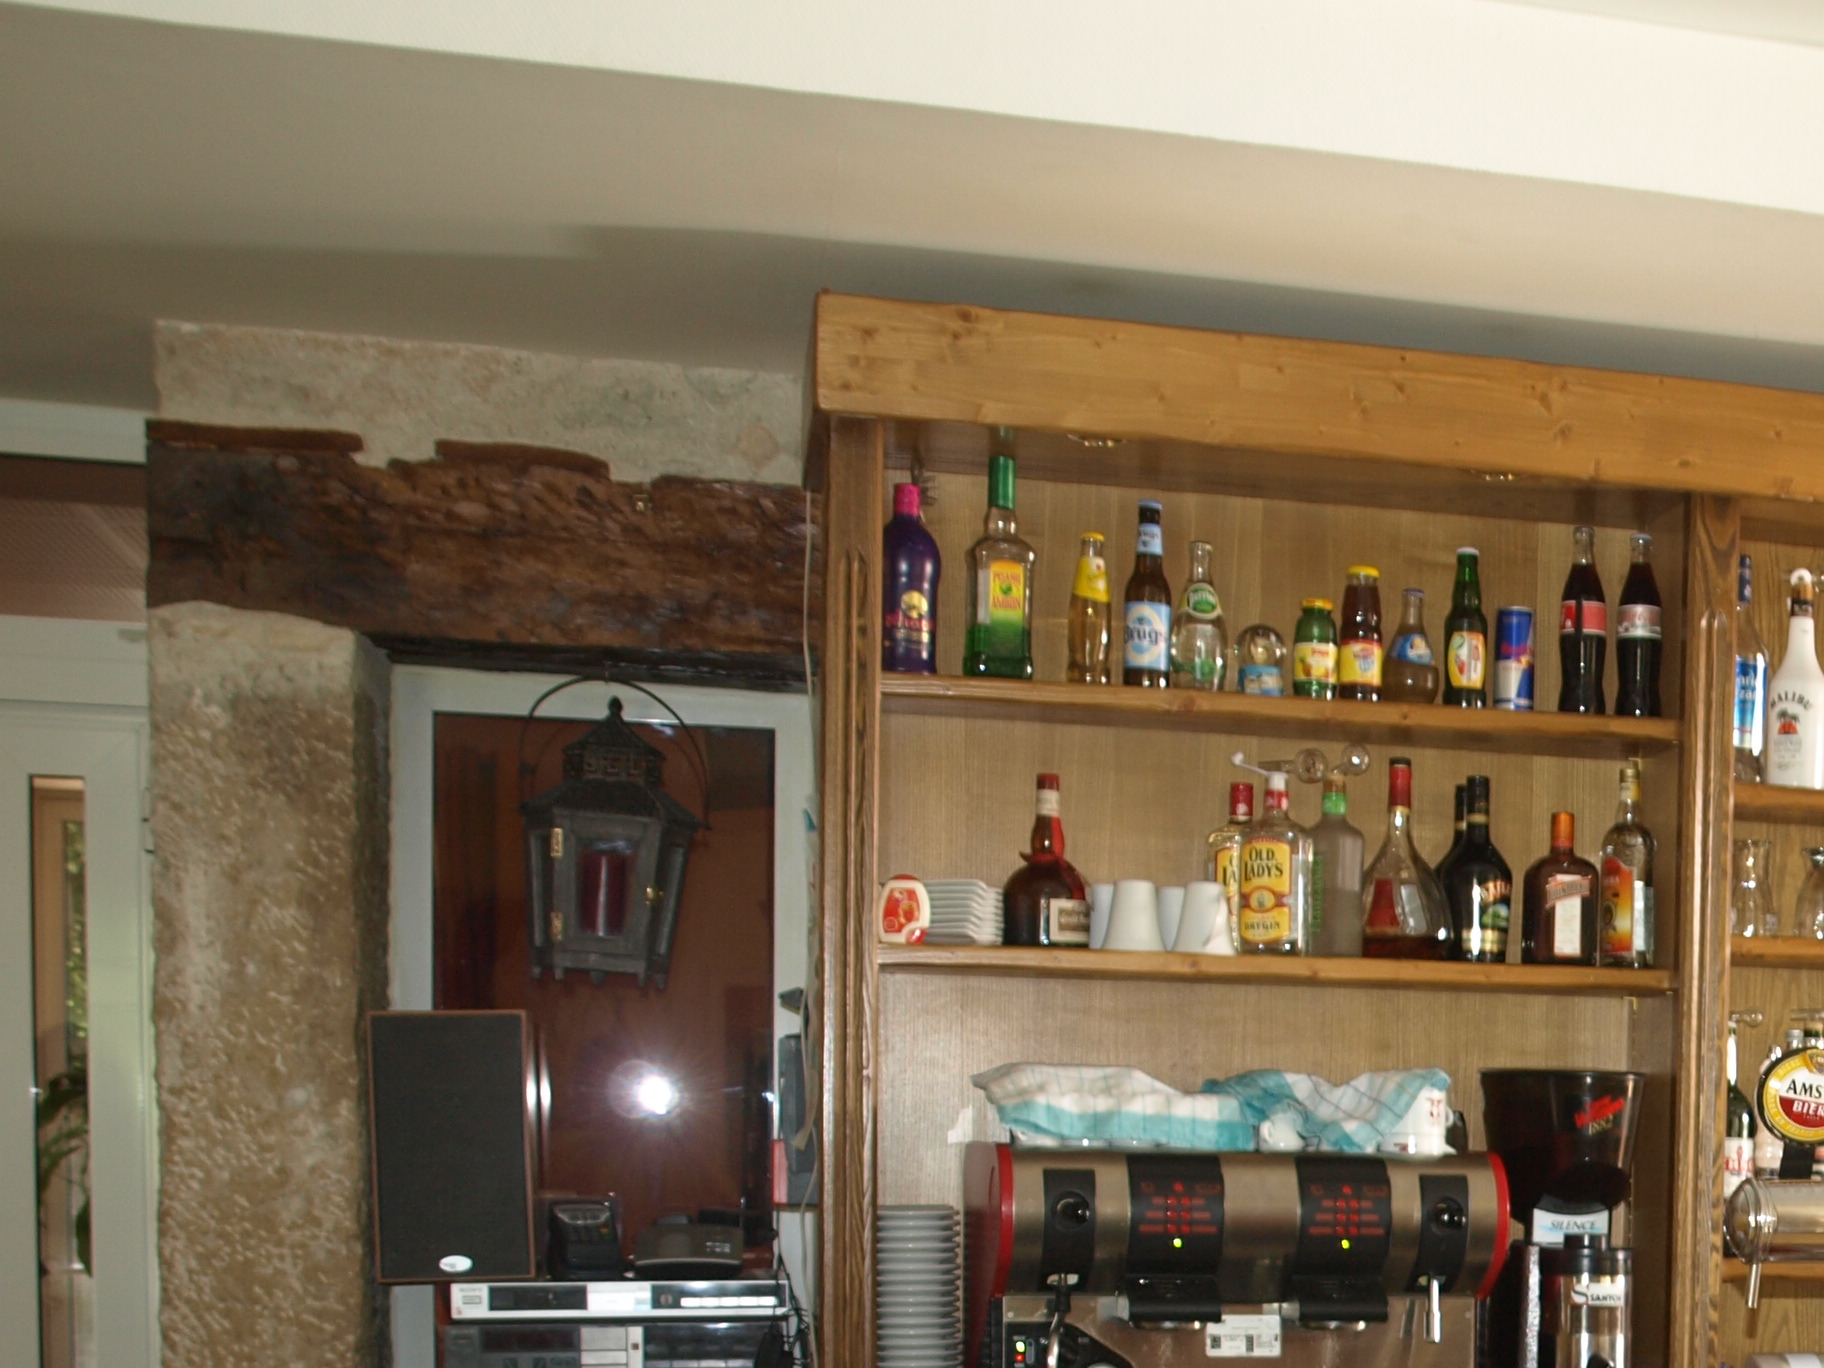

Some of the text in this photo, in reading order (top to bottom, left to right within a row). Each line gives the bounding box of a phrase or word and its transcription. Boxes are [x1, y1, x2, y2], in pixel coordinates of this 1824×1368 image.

[1770, 690, 1813, 710] MALIBU
[1249, 846, 1275, 861] OLD
[1551, 1219, 1597, 1231] SILENCE
